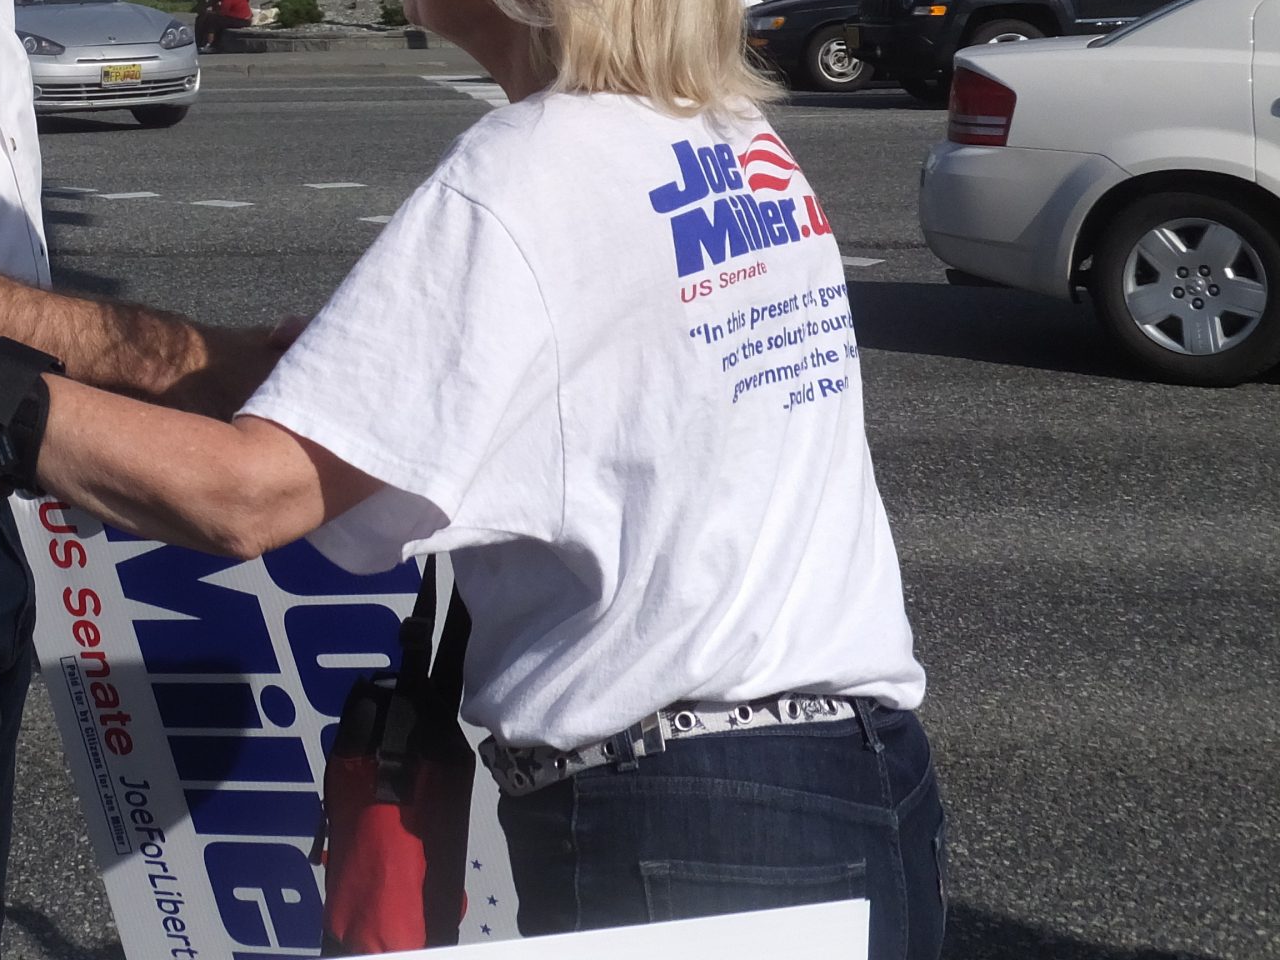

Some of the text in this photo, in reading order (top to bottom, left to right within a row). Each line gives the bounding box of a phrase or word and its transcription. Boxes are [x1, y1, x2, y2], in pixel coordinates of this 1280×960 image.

[649, 140, 743, 214] Joe
[680, 261, 767, 303] US Senate
[727, 310, 746, 334] this
[750, 294, 799, 330] present
[741, 338, 763, 360] the
[806, 320, 819, 337] to
[821, 315, 846, 333] our
[810, 348, 839, 368] the
[39, 502, 133, 756] US Senate
[103, 523, 324, 960] Mille
